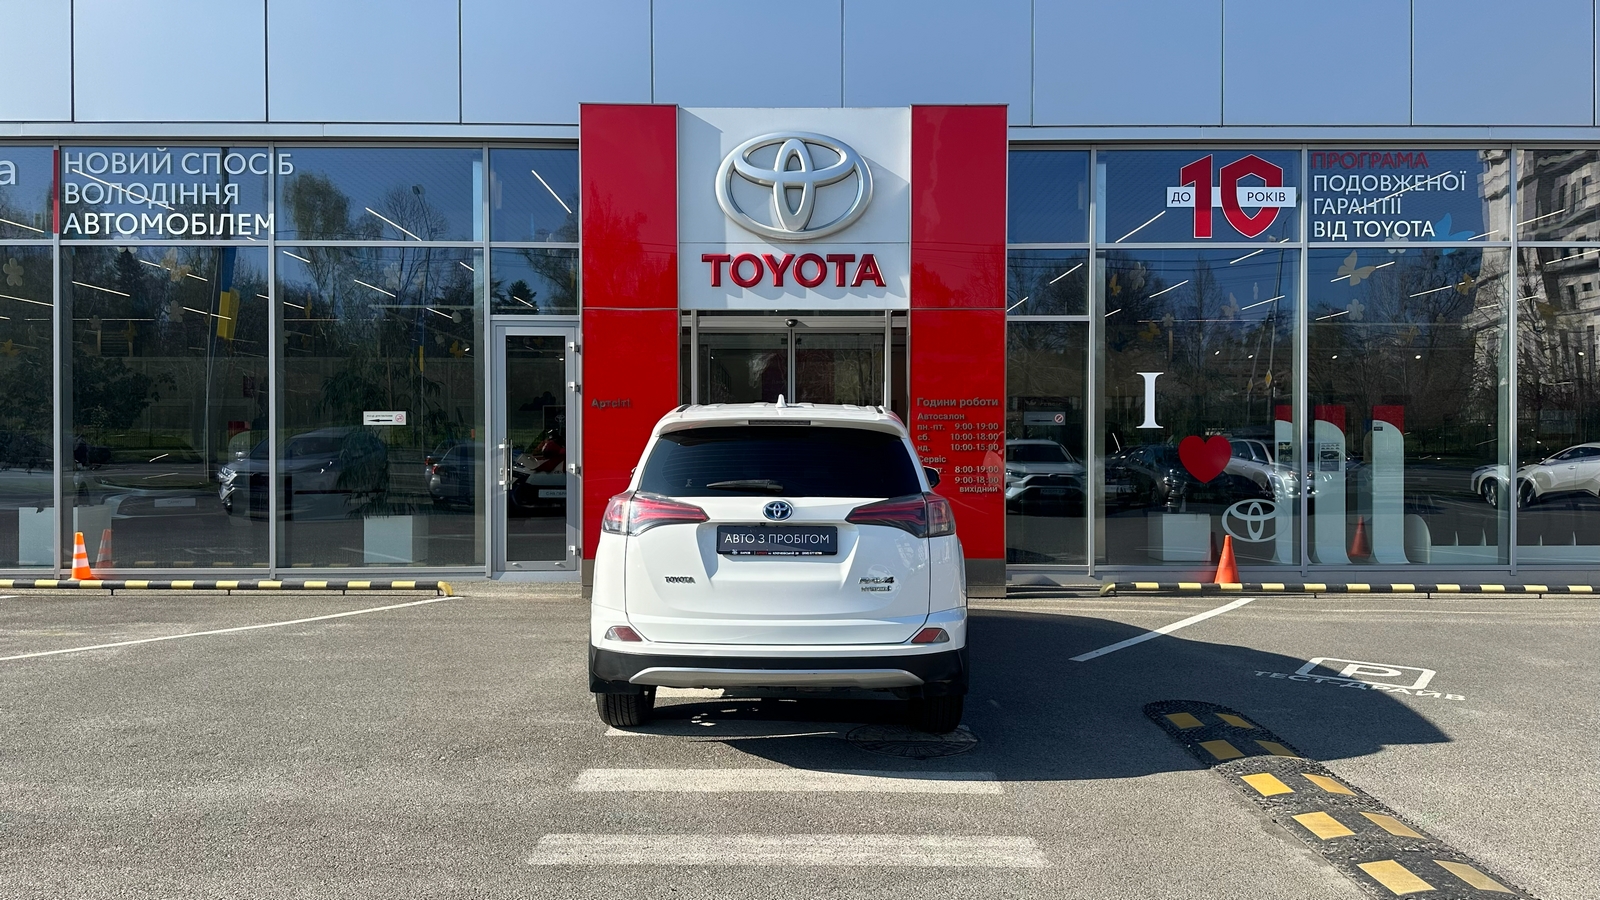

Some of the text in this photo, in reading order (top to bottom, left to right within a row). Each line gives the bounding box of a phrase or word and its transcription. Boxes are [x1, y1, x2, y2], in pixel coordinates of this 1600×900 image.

[64, 147, 294, 175] НОВИЙ СПОСІБ
[1311, 151, 1430, 170] ПРОГРАМА
[1313, 170, 1467, 195] ПОДОВЖЕНОЇ
[64, 182, 239, 209] ВОЛОДІННЯ
[1171, 154, 1286, 239] ДО 10 РОКІВ
[1313, 195, 1401, 215] ГАРАНТІЇ
[63, 212, 275, 235] АВТОМОБІЛЕМ
[1314, 220, 1436, 241] ВІД TOYOTA
[701, 252, 887, 288] TOYOTA
[916, 397, 999, 409] Години роботи
[1136, 372, 1164, 429] I
[917, 412, 965, 421] Автосалон
[954, 422, 999, 431] 9:00-19:00
[917, 433, 999, 442] сб. 10:00-18:00
[950, 443, 999, 452] 10:00-15:00
[954, 466, 999, 474] 8:00-19:00
[954, 476, 999, 484] 9:00-18:00
[959, 485, 998, 494] вихідний
[724, 533, 755, 544] АВТО
[768, 533, 830, 544] ПРОБІГОМ
[664, 576, 696, 584] TOYOTA
[1254, 670, 1466, 701] ТЕСТ-ДРАЙВ
